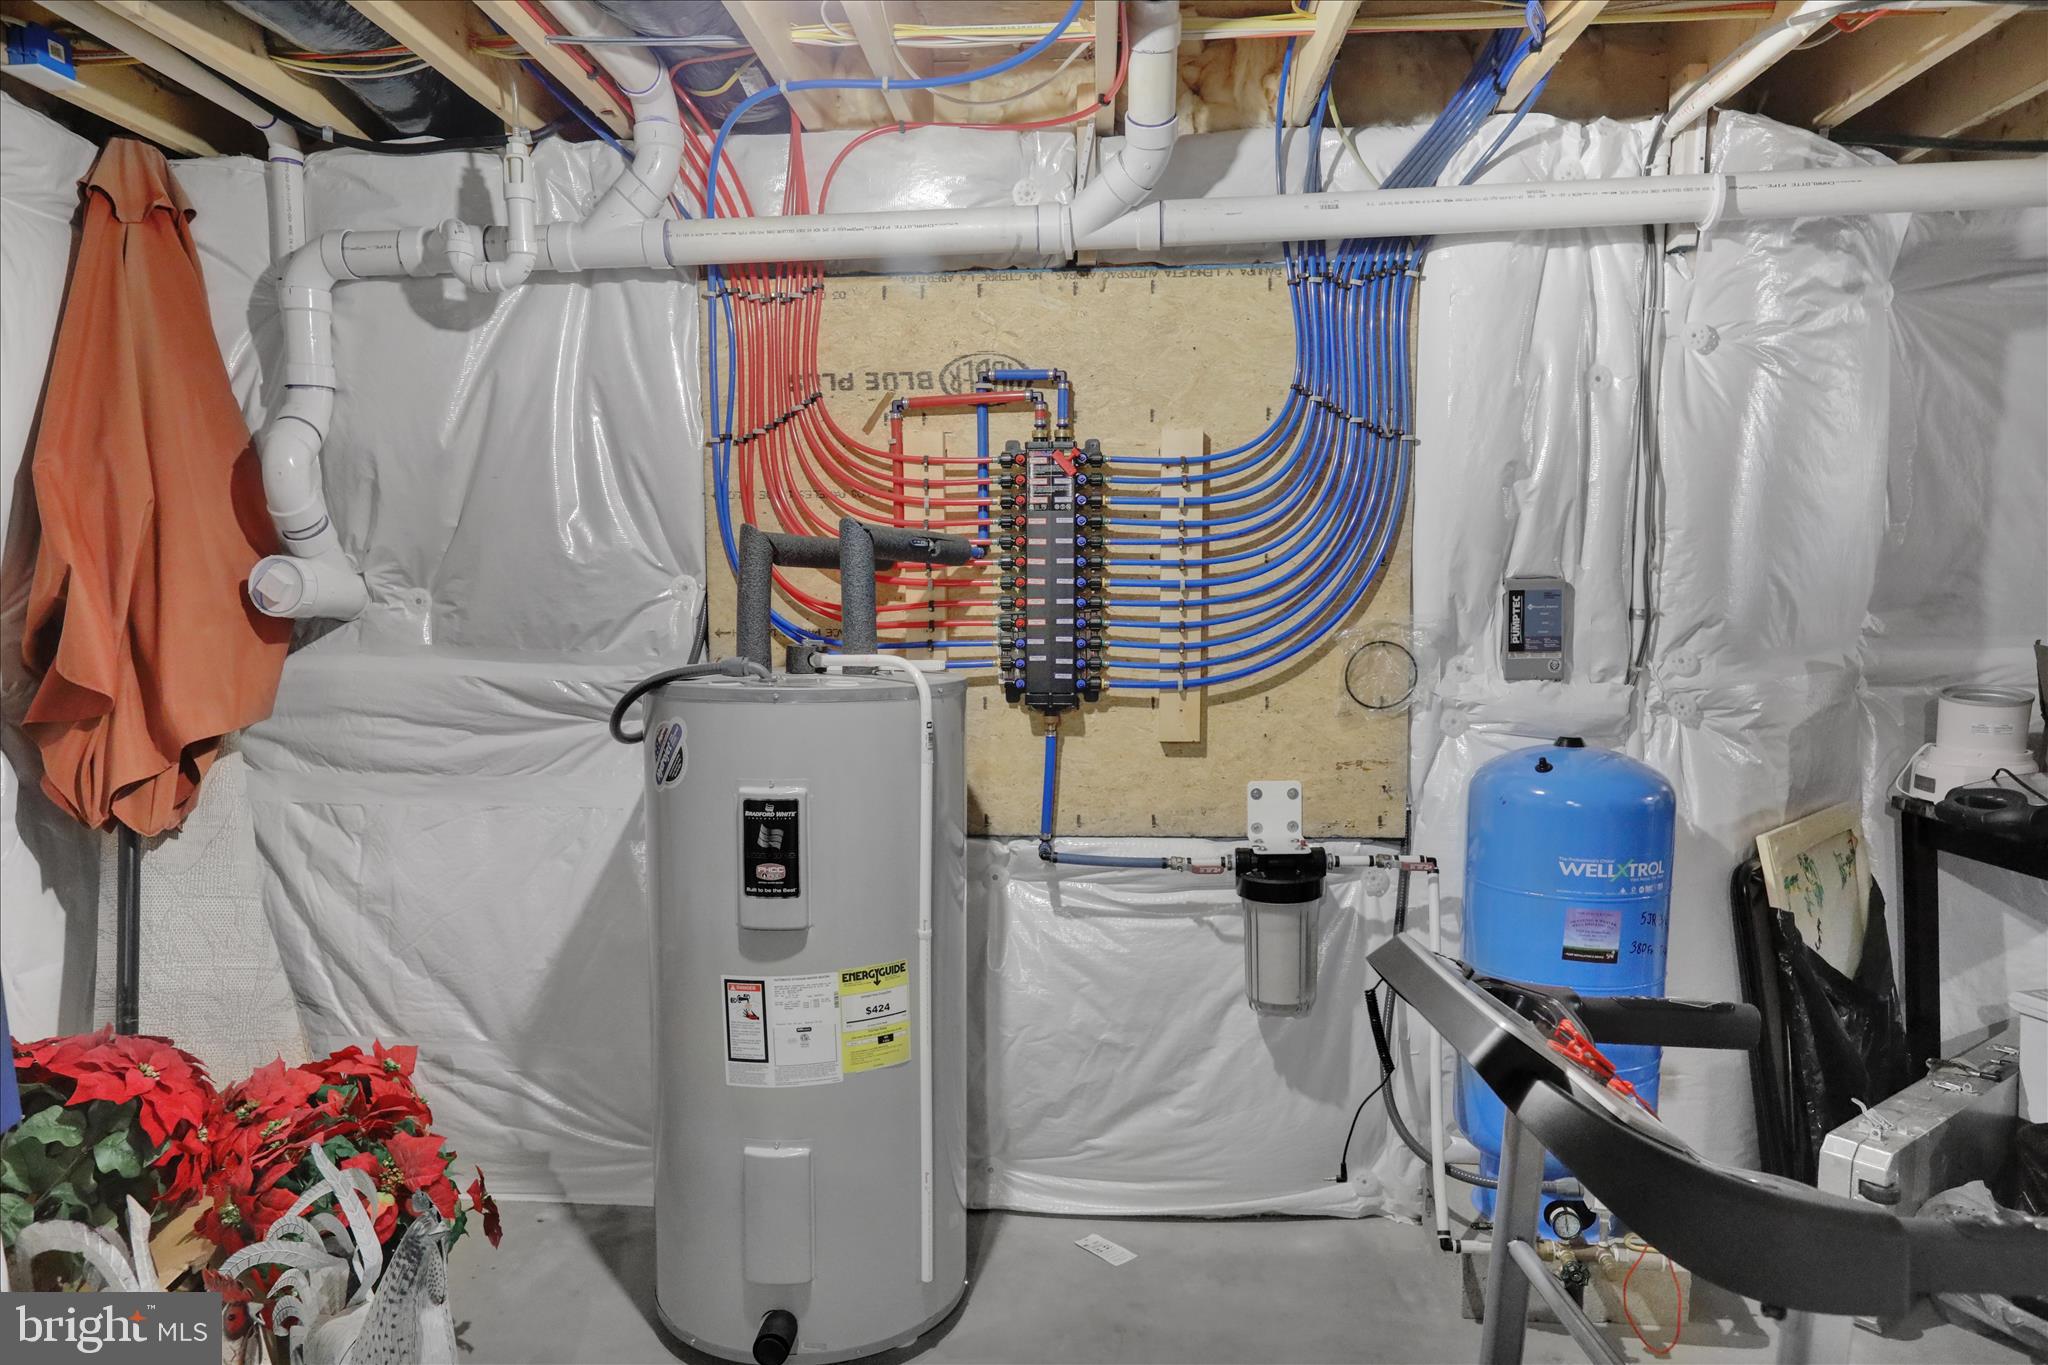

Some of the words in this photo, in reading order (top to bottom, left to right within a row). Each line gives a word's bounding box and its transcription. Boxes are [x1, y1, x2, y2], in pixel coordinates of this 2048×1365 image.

[864, 371, 934, 391] BLUE
[1511, 595, 1521, 644] PUMPTEC
[865, 1003, 890, 1015] $424
